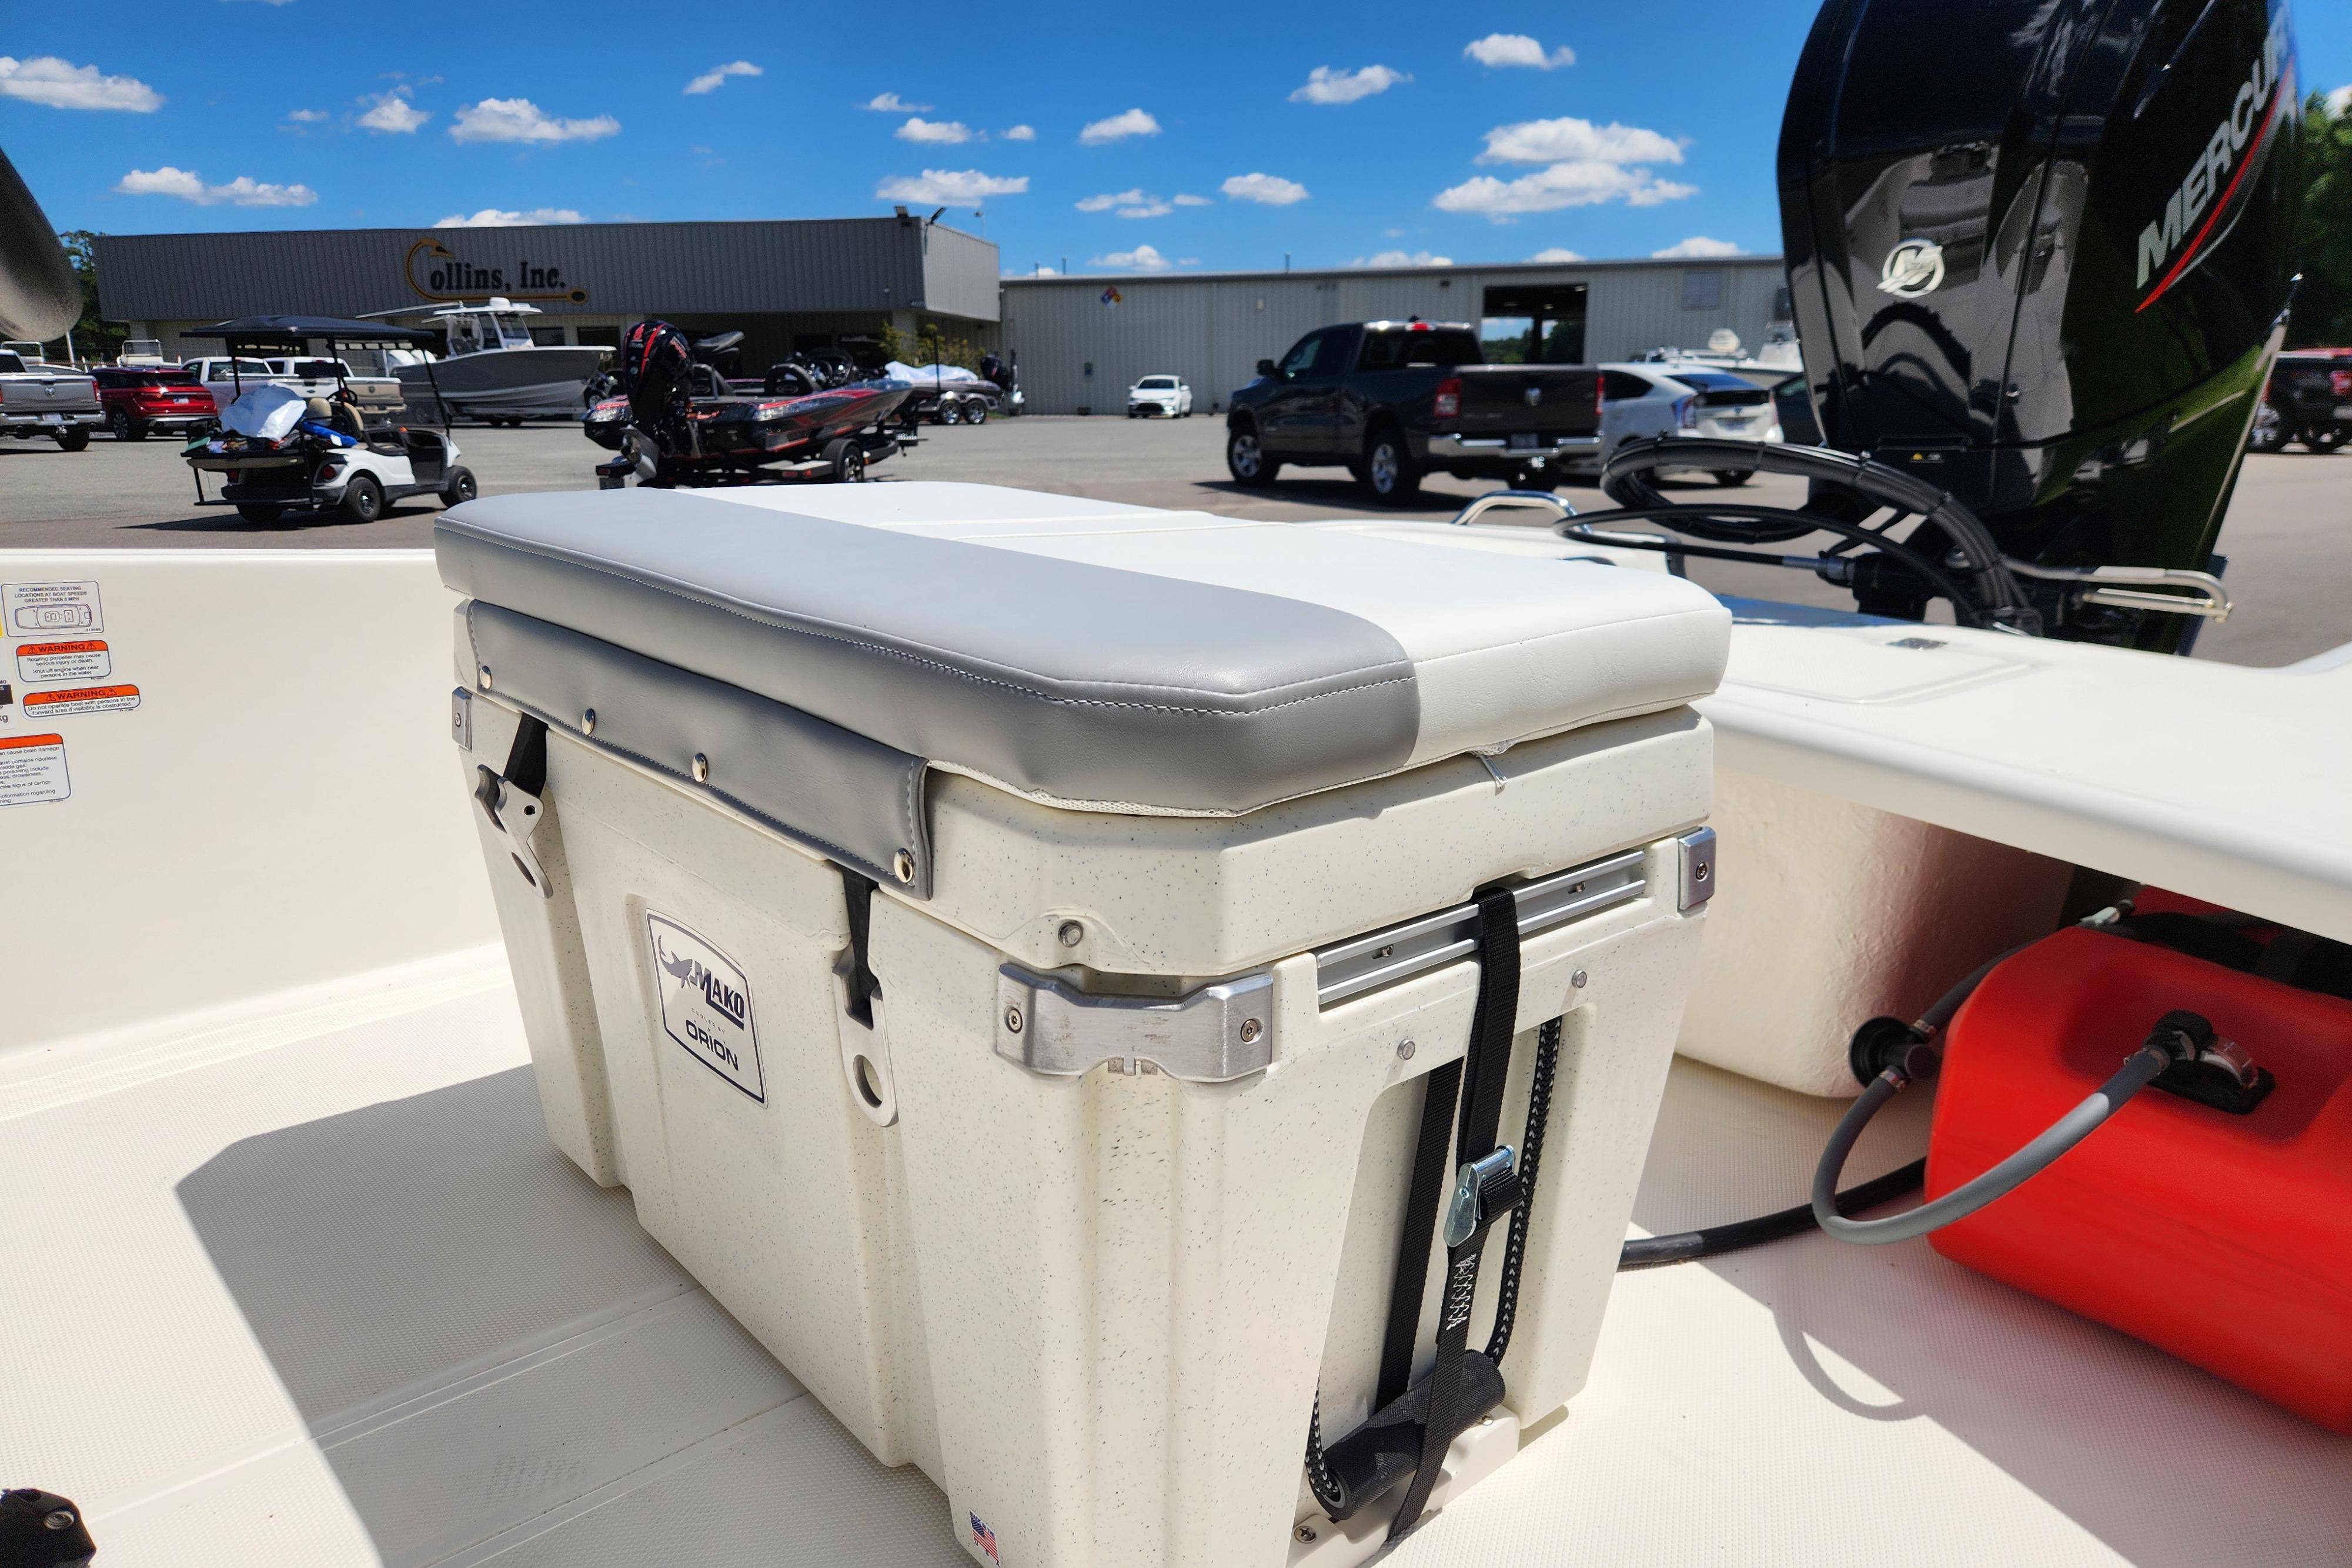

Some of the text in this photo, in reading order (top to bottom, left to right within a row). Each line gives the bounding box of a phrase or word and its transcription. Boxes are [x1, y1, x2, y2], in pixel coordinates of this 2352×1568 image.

[2137, 1, 2291, 289] MERCUR
[520, 262, 566, 289] Inc.
[38, 644, 85, 653] WARNING
[56, 689, 106, 699] WARNING
[690, 960, 744, 1031] MAKO
[686, 1019, 739, 1072] ORION
